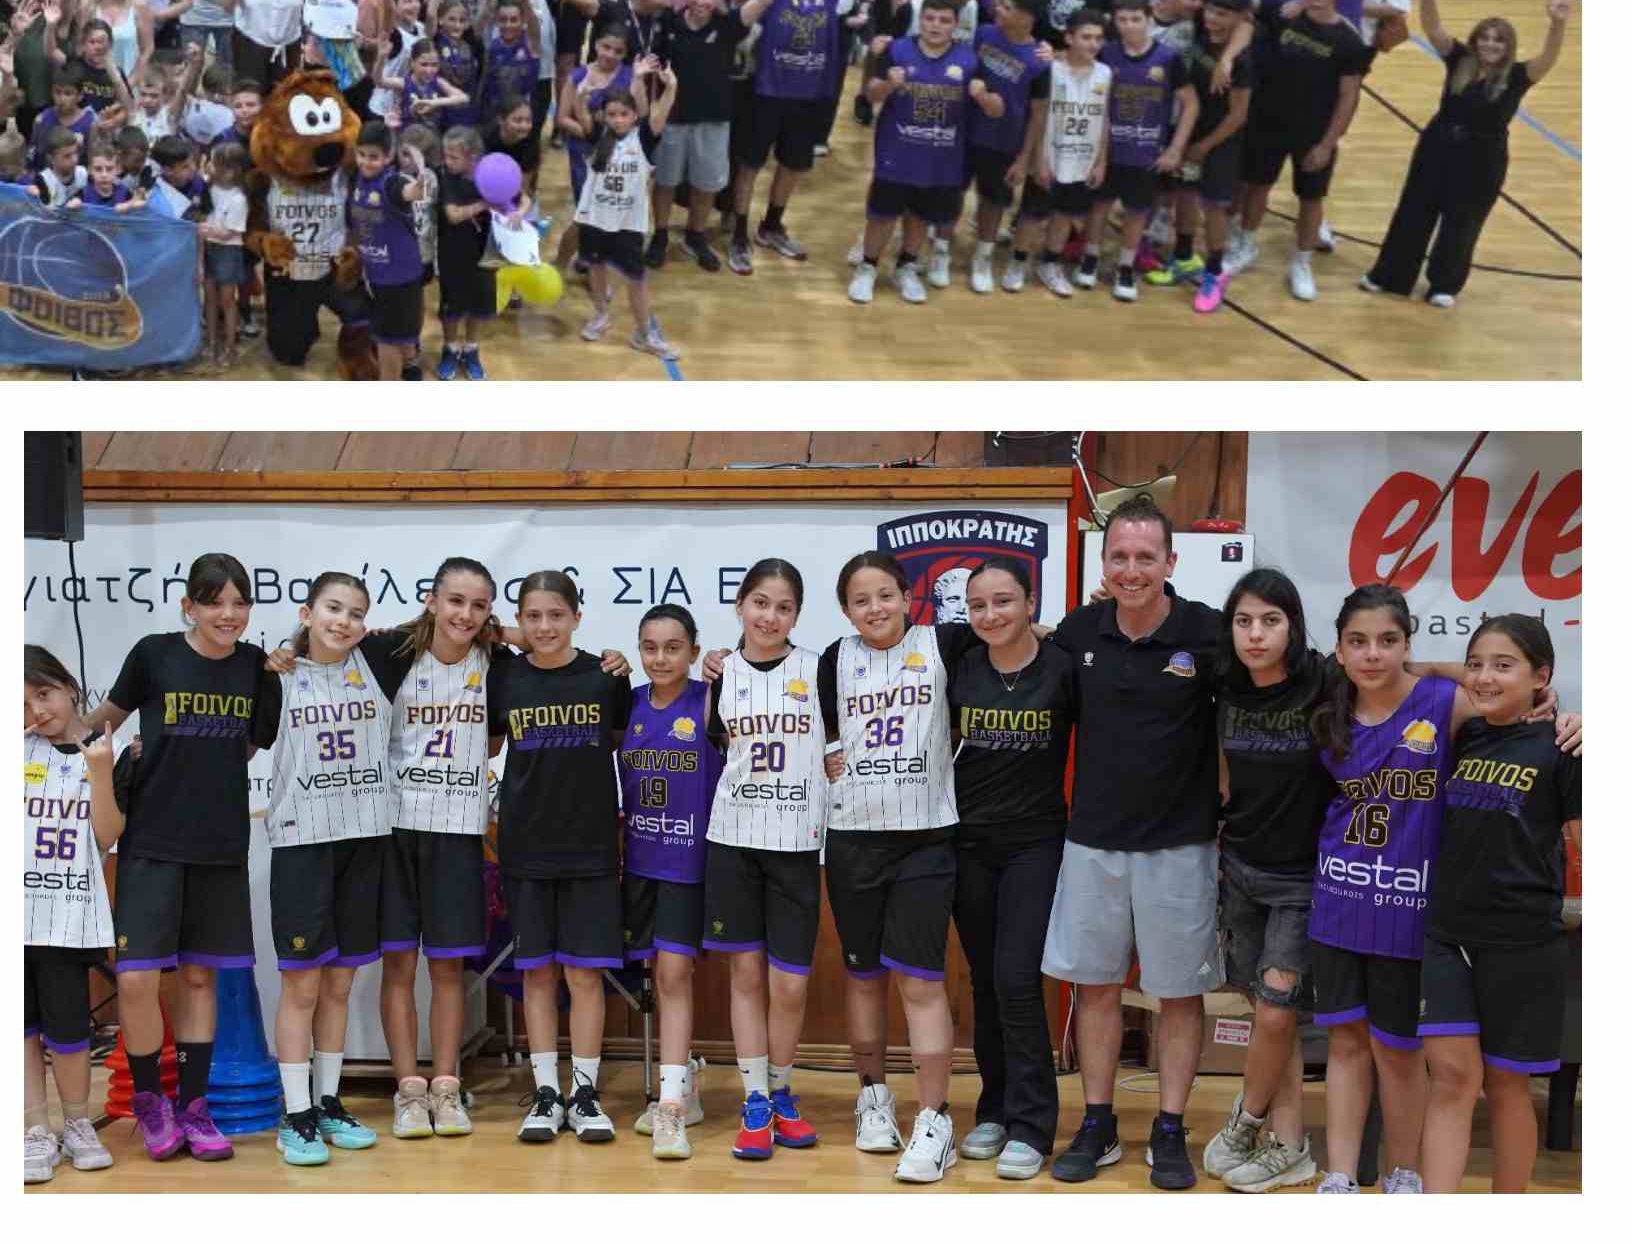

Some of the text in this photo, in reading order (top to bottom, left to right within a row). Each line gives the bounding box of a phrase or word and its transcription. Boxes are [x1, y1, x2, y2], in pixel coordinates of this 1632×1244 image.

[291, 223, 319, 244] 27
[886, 518, 1039, 549] ΙΠΠΟΚΡΑΤΗΣ
[612, 566, 692, 605] ΣΙΑ
[179, 693, 254, 719] FOIVOS
[407, 702, 485, 725] FOIVOS
[846, 683, 933, 718] FOIVOS
[290, 701, 376, 728] FOIVOS
[523, 704, 601, 728] FOIVOS
[728, 712, 811, 739] FOIVOS
[970, 708, 1051, 733] FOIVOS
[316, 730, 357, 762] 35
[425, 729, 454, 758] 21
[865, 716, 905, 750] 36
[970, 730, 1052, 743] BASKETBALL
[749, 741, 786, 774] 20
[298, 762, 383, 790] vestal
[397, 762, 479, 787] vestal
[894, 774, 929, 786] group
[1457, 758, 1538, 792] FOIVOS
[351, 785, 385, 798] group
[445, 786, 480, 799] group
[639, 777, 668, 809] 19
[730, 778, 807, 803] vestal
[24, 797, 91, 820] OIVO
[776, 801, 808, 813] group
[627, 812, 695, 838] vestal
[1344, 803, 1391, 847] 16
[35, 826, 78, 861] 56
[663, 835, 695, 848] group
[1319, 851, 1429, 893] vestal
[1374, 892, 1428, 912] group
